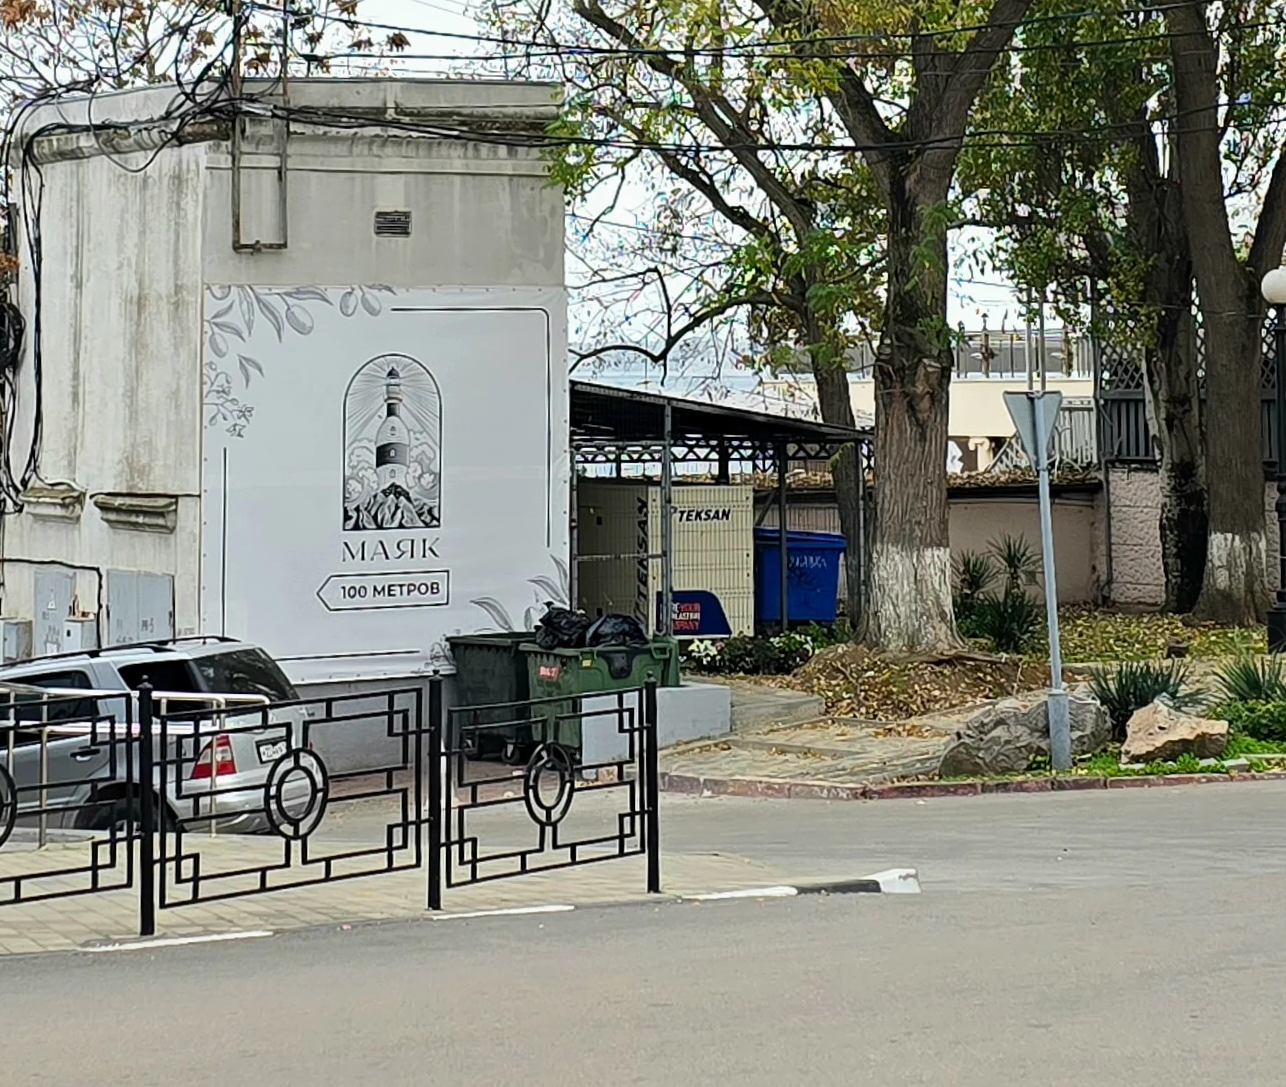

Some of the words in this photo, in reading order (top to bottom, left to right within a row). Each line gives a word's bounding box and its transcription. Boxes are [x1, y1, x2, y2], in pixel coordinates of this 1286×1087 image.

[678, 508, 731, 523] TEKSAN
[342, 537, 441, 563] МАЯК
[341, 584, 368, 600] 100
[372, 581, 441, 599] МЕТРОВ
